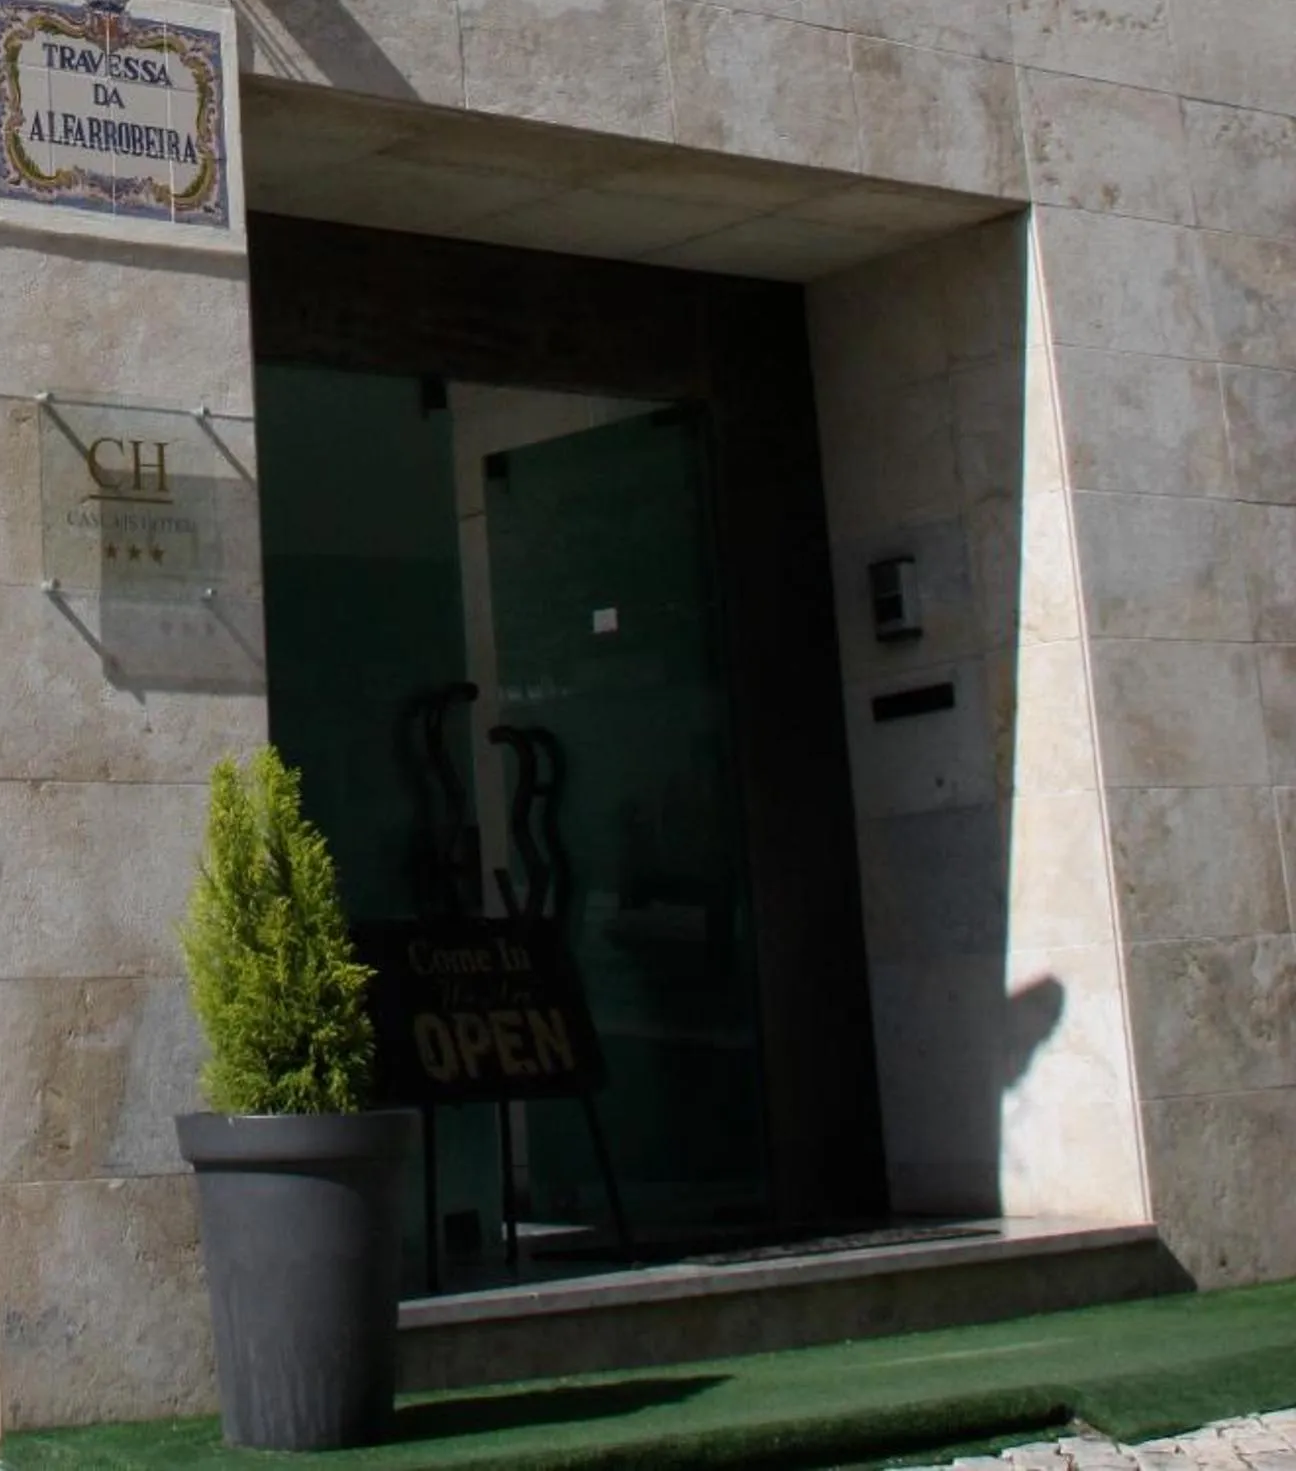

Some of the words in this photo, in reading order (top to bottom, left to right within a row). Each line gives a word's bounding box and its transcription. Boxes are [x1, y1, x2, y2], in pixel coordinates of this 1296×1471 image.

[42, 42, 173, 87] TRAVESSA
[92, 83, 126, 110] DA
[29, 110, 198, 165] ALFARROBEIRA
[87, 436, 170, 493] CH
[413, 1005, 576, 1083] OPEN
